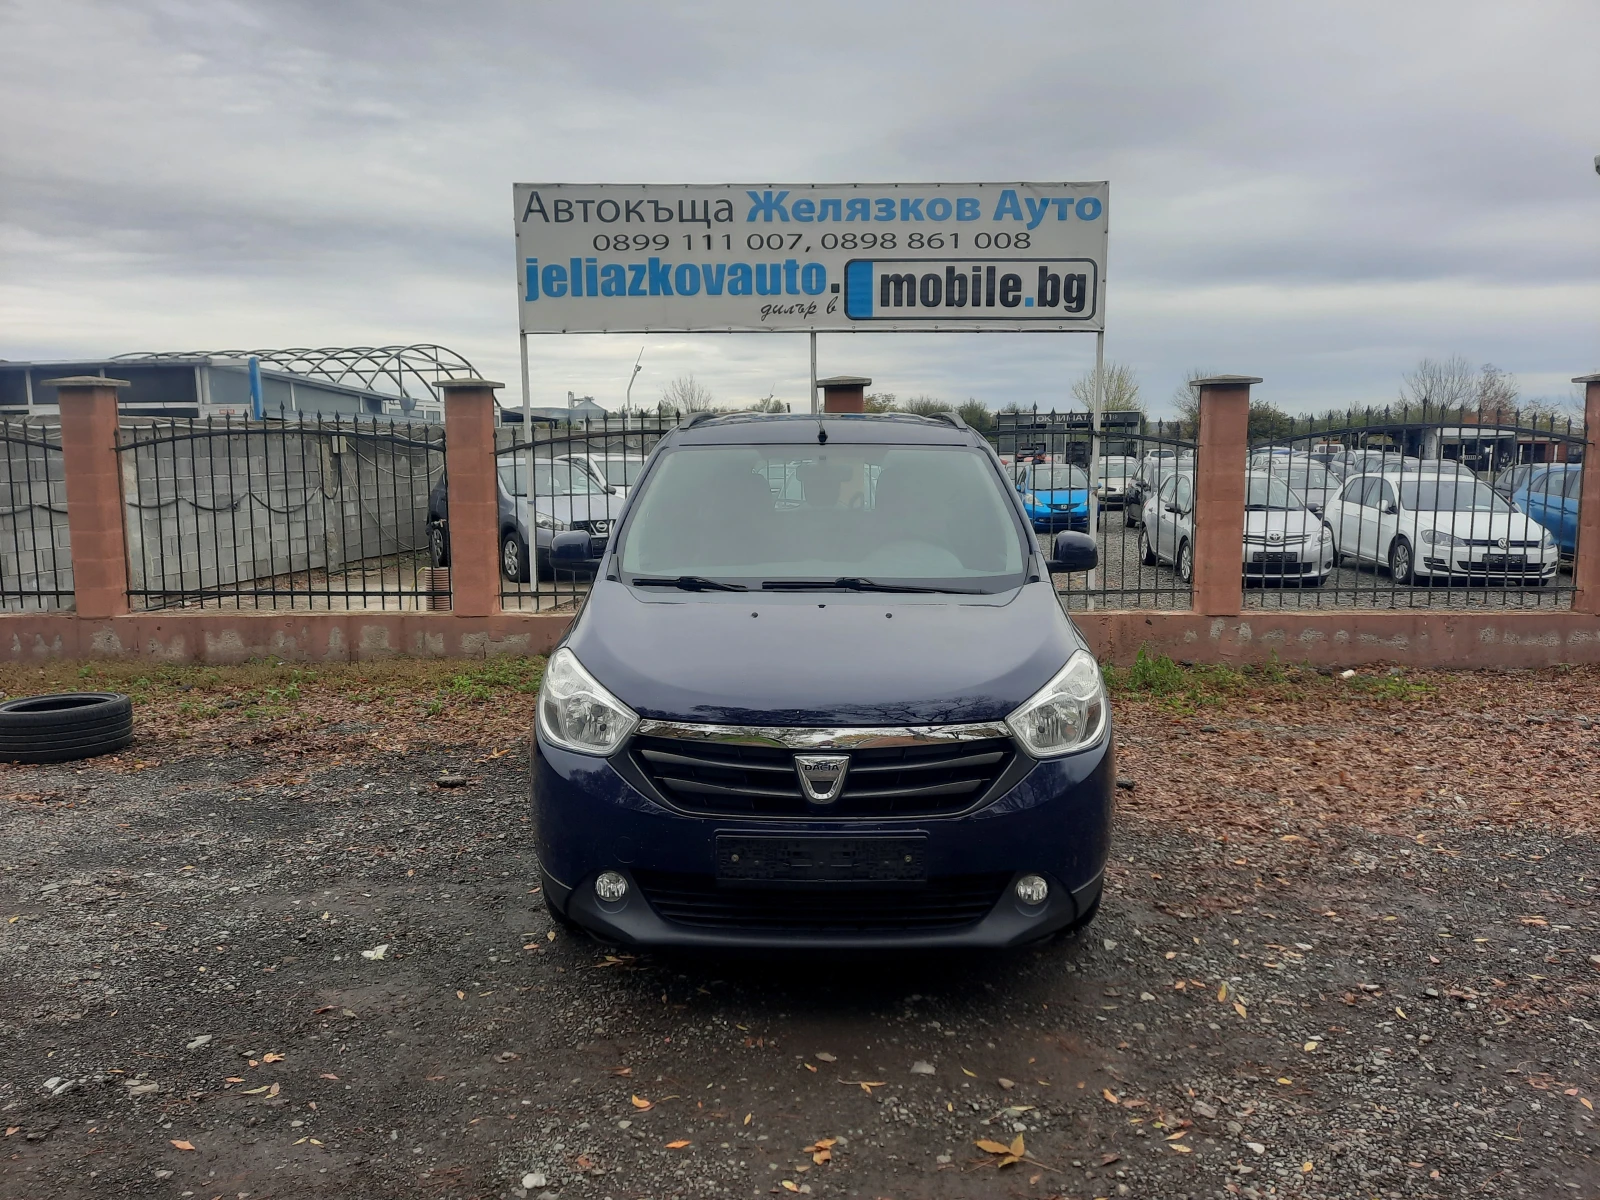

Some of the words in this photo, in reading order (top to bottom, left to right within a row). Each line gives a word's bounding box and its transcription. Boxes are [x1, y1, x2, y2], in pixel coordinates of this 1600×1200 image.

[521, 190, 734, 229] Автокъща
[745, 190, 981, 223] Желязков
[992, 189, 1102, 231] Ауто
[592, 233, 670, 251] 0899
[682, 233, 732, 251] 111
[746, 233, 811, 253] 007,
[820, 232, 897, 250] 0898
[907, 232, 959, 249] 861
[974, 232, 1031, 249] 008
[880, 265, 1087, 313] mobile.bg
